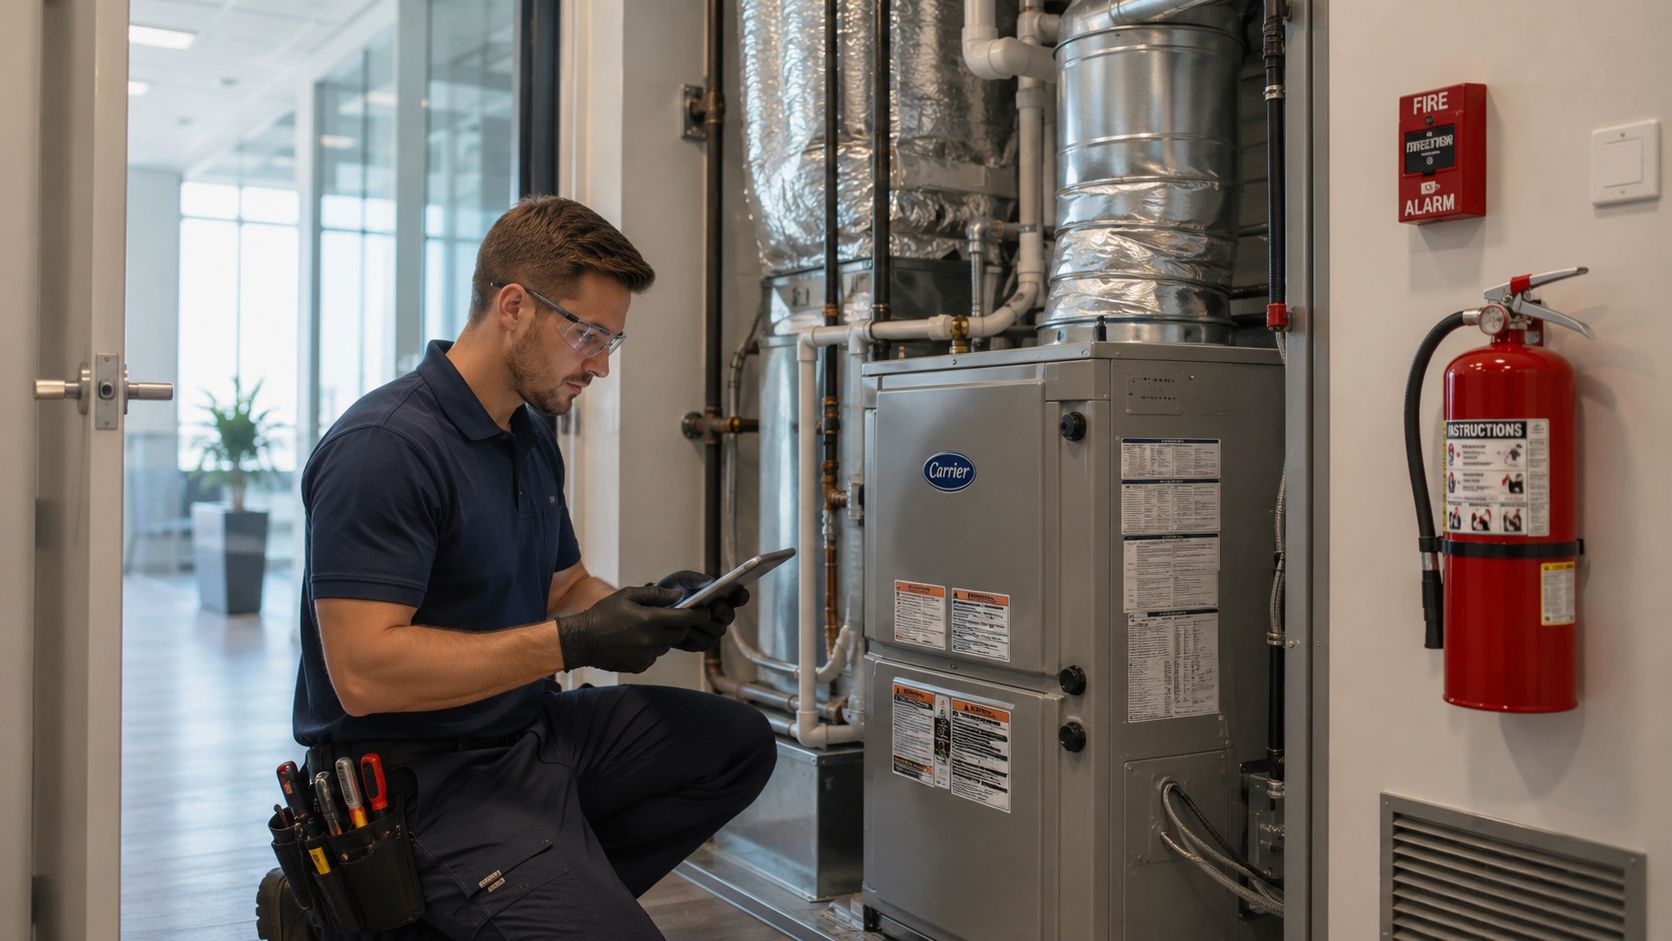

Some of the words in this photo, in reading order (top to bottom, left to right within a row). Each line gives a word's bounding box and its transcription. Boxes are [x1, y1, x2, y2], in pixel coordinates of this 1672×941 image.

[1413, 92, 1448, 115] FIRE
[1405, 194, 1455, 217] ALARM
[1448, 423, 1522, 437] INSTRUCTIONS
[929, 461, 970, 479] Carrier
